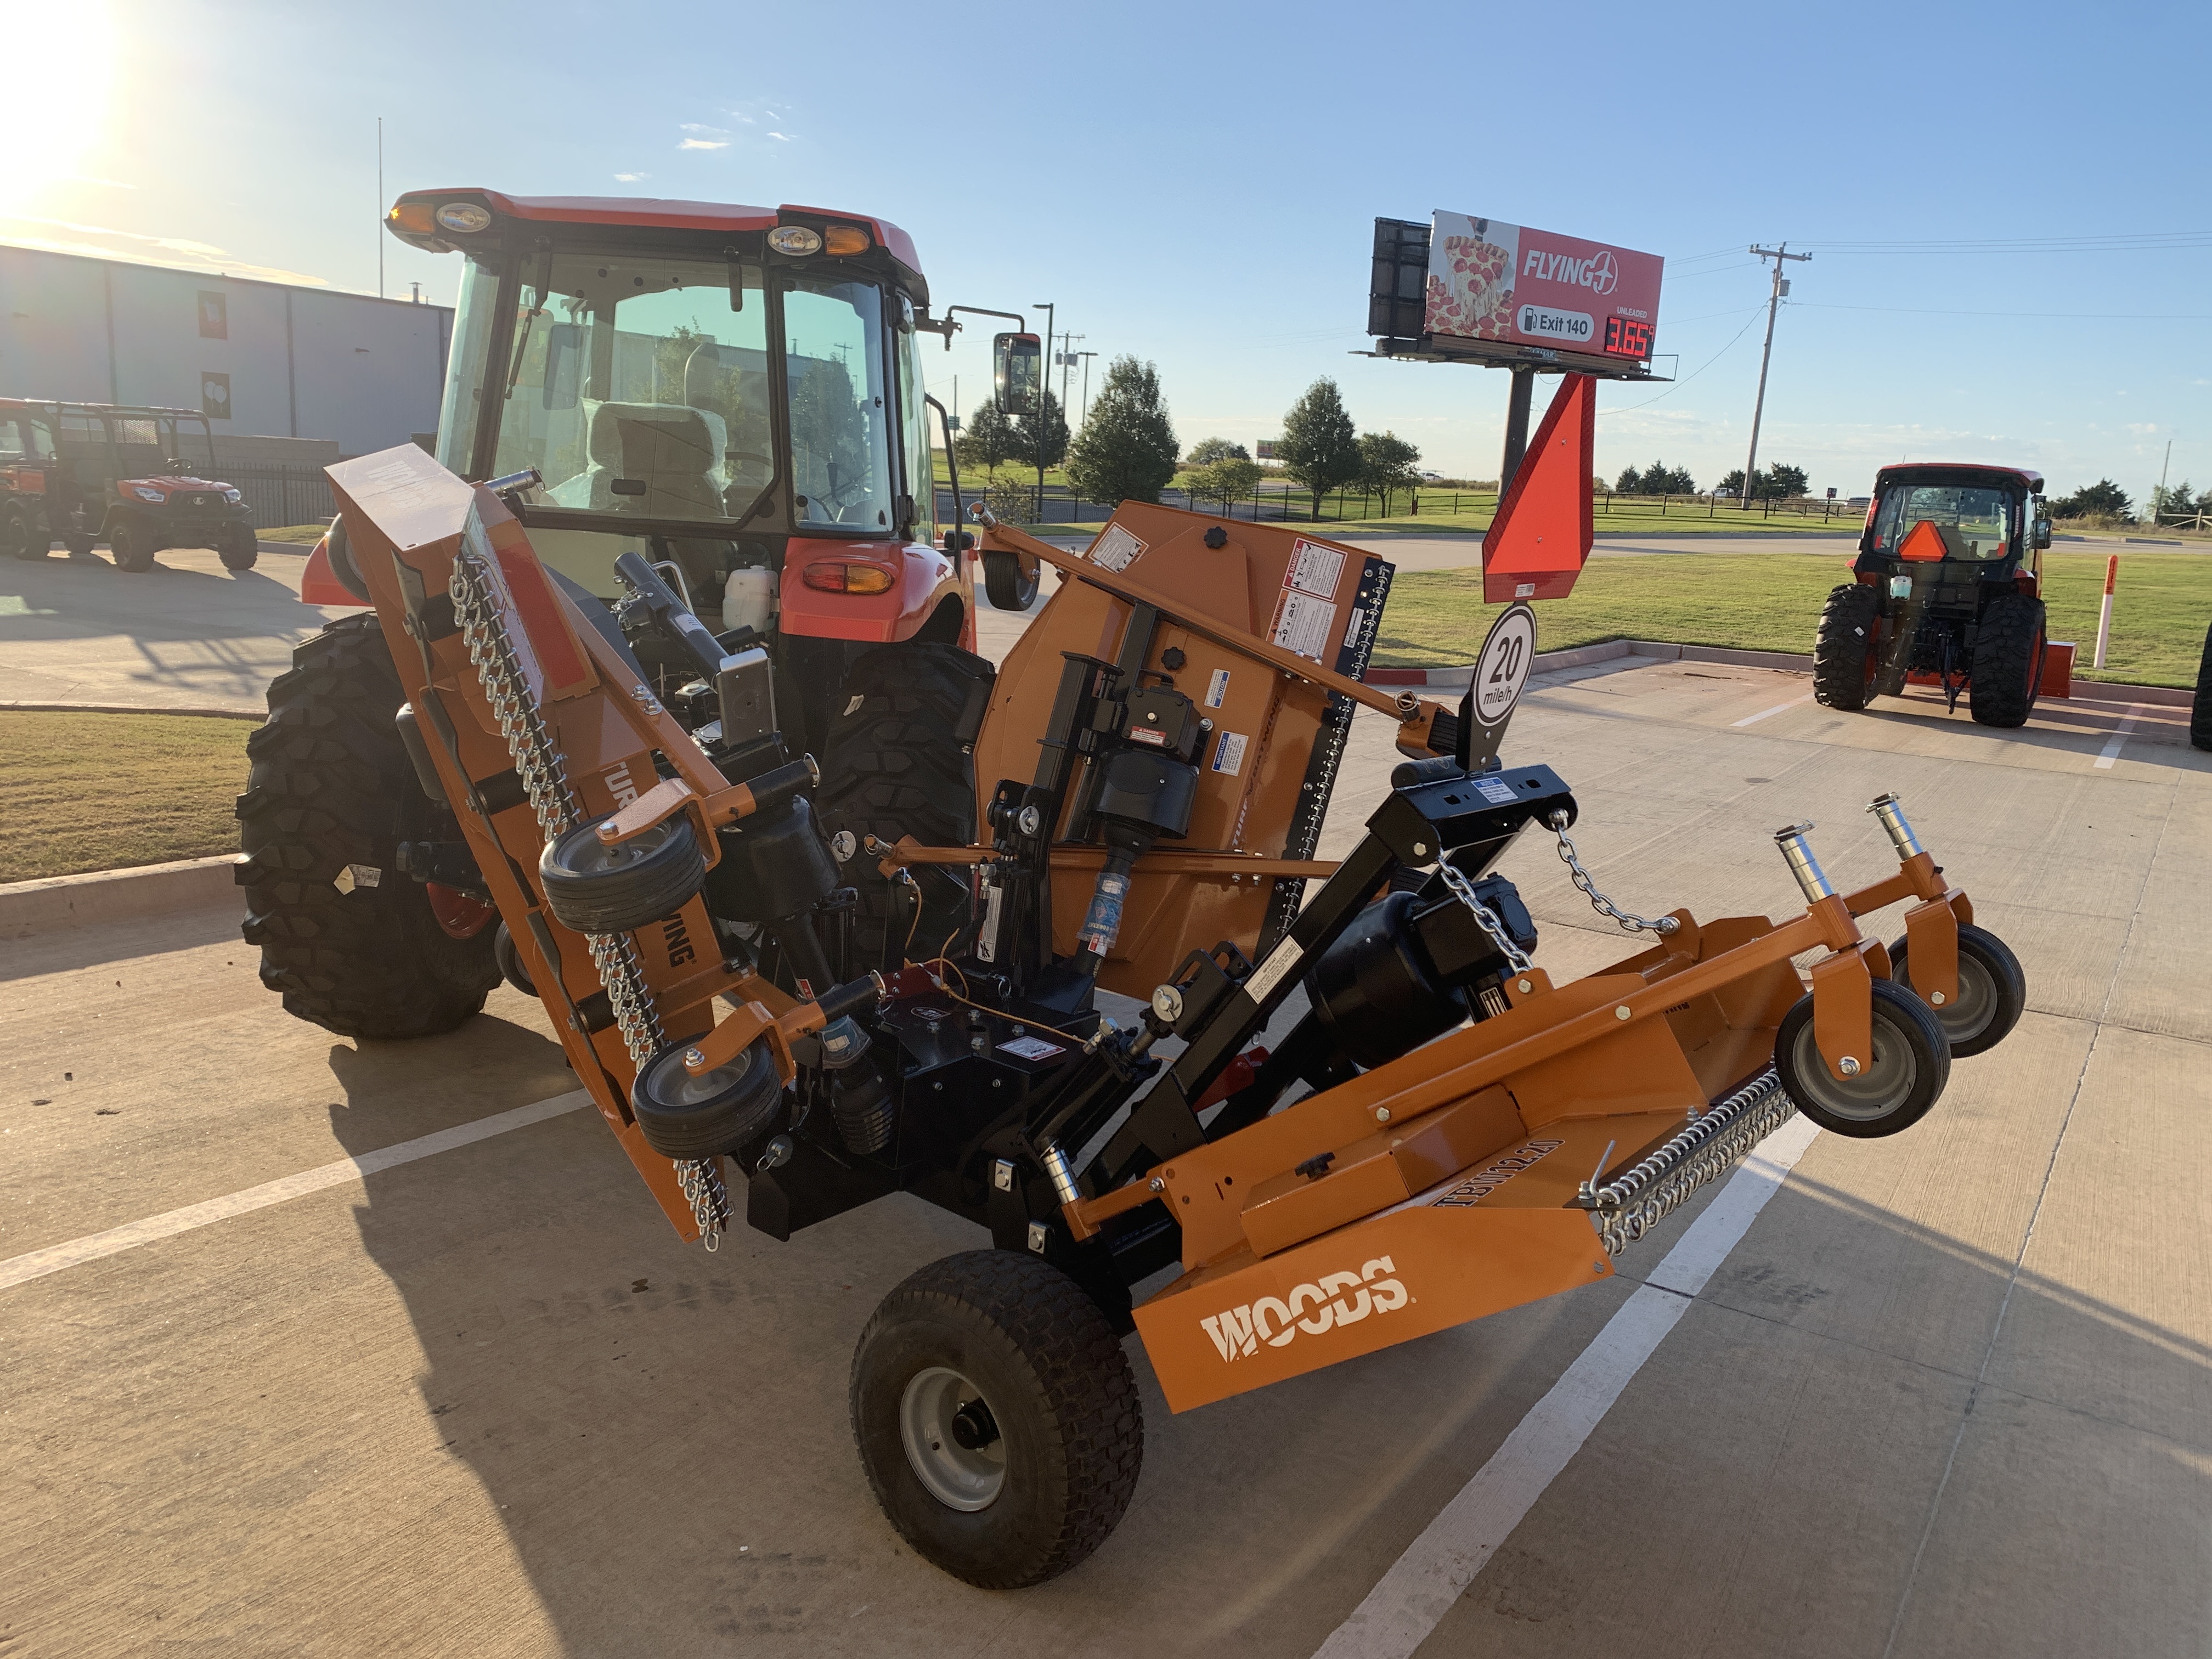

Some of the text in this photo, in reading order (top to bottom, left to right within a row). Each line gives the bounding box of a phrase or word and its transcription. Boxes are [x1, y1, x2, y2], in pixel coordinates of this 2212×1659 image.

[1523, 250, 1594, 287] FLYING
[1540, 314, 1588, 335] Exit 140
[1617, 306, 1647, 319] UNLEADED
[1289, 548, 1301, 572] DANGER
[1273, 598, 1285, 627] WARNING
[1488, 635, 1523, 684] 20
[1217, 680, 1226, 699] NOTICE
[1483, 686, 1513, 705] mile/h
[1216, 738, 1227, 765] IMPORTANT
[1232, 798, 1248, 846] TURF
[1430, 1139, 1565, 1207] TBW12.20
[1200, 1255, 1408, 1363] WOODS
